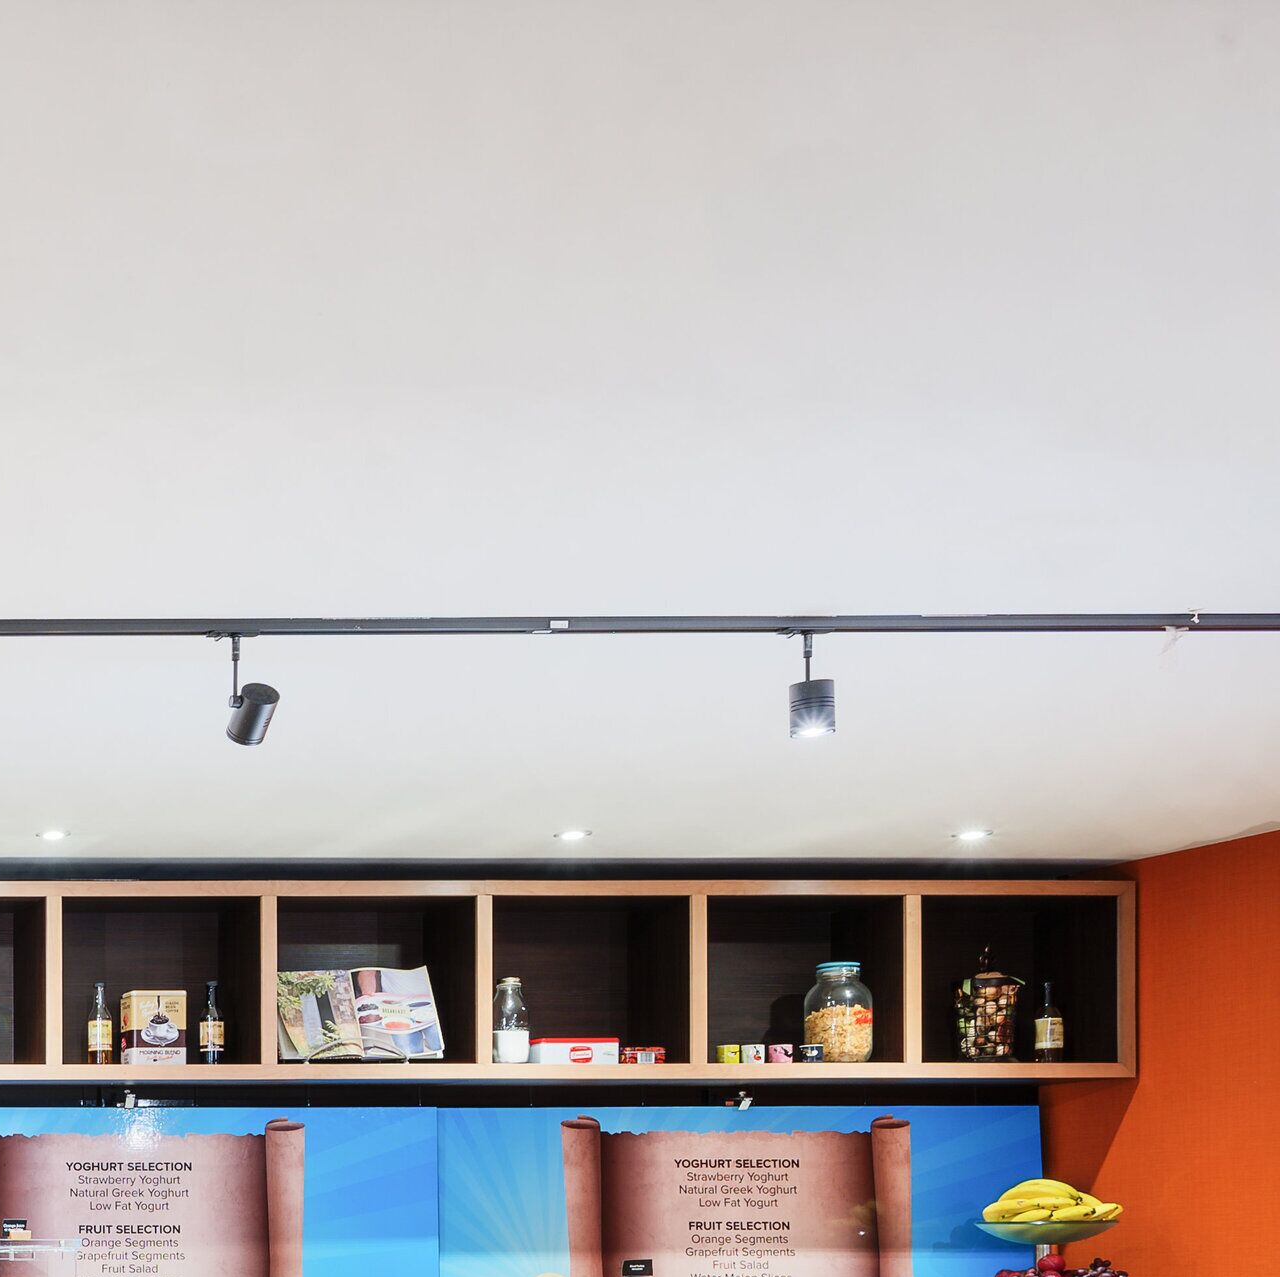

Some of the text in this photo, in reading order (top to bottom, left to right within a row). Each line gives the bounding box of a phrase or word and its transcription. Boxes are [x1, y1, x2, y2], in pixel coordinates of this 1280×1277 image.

[66, 1162, 192, 1172] YOGHURT SELECTION
[674, 1159, 800, 1168] YOGHURT SELECTION
[78, 1175, 181, 1186] Strawberry Yoghurt
[687, 1172, 789, 1183] Strawberry Yoghurt
[69, 1188, 189, 1199] Natural Greek Yoghurt
[679, 1185, 797, 1196] Natural Greek Yoghurt
[90, 1201, 169, 1212] Low Fat Yogurt
[699, 1198, 778, 1209] Low Fat Yogurt
[78, 1225, 181, 1234] FRUIT SELECTION
[688, 1221, 790, 1231] FRUIT SELECTION
[81, 1238, 179, 1249] Orange Segments
[691, 1234, 789, 1246] Orange Segments
[76, 1251, 186, 1263] Grapefruit Segments
[685, 1247, 796, 1259] Grapefruit Segments
[101, 1264, 159, 1273] Fruit Salad
[713, 1260, 769, 1270] Fruit Salad
